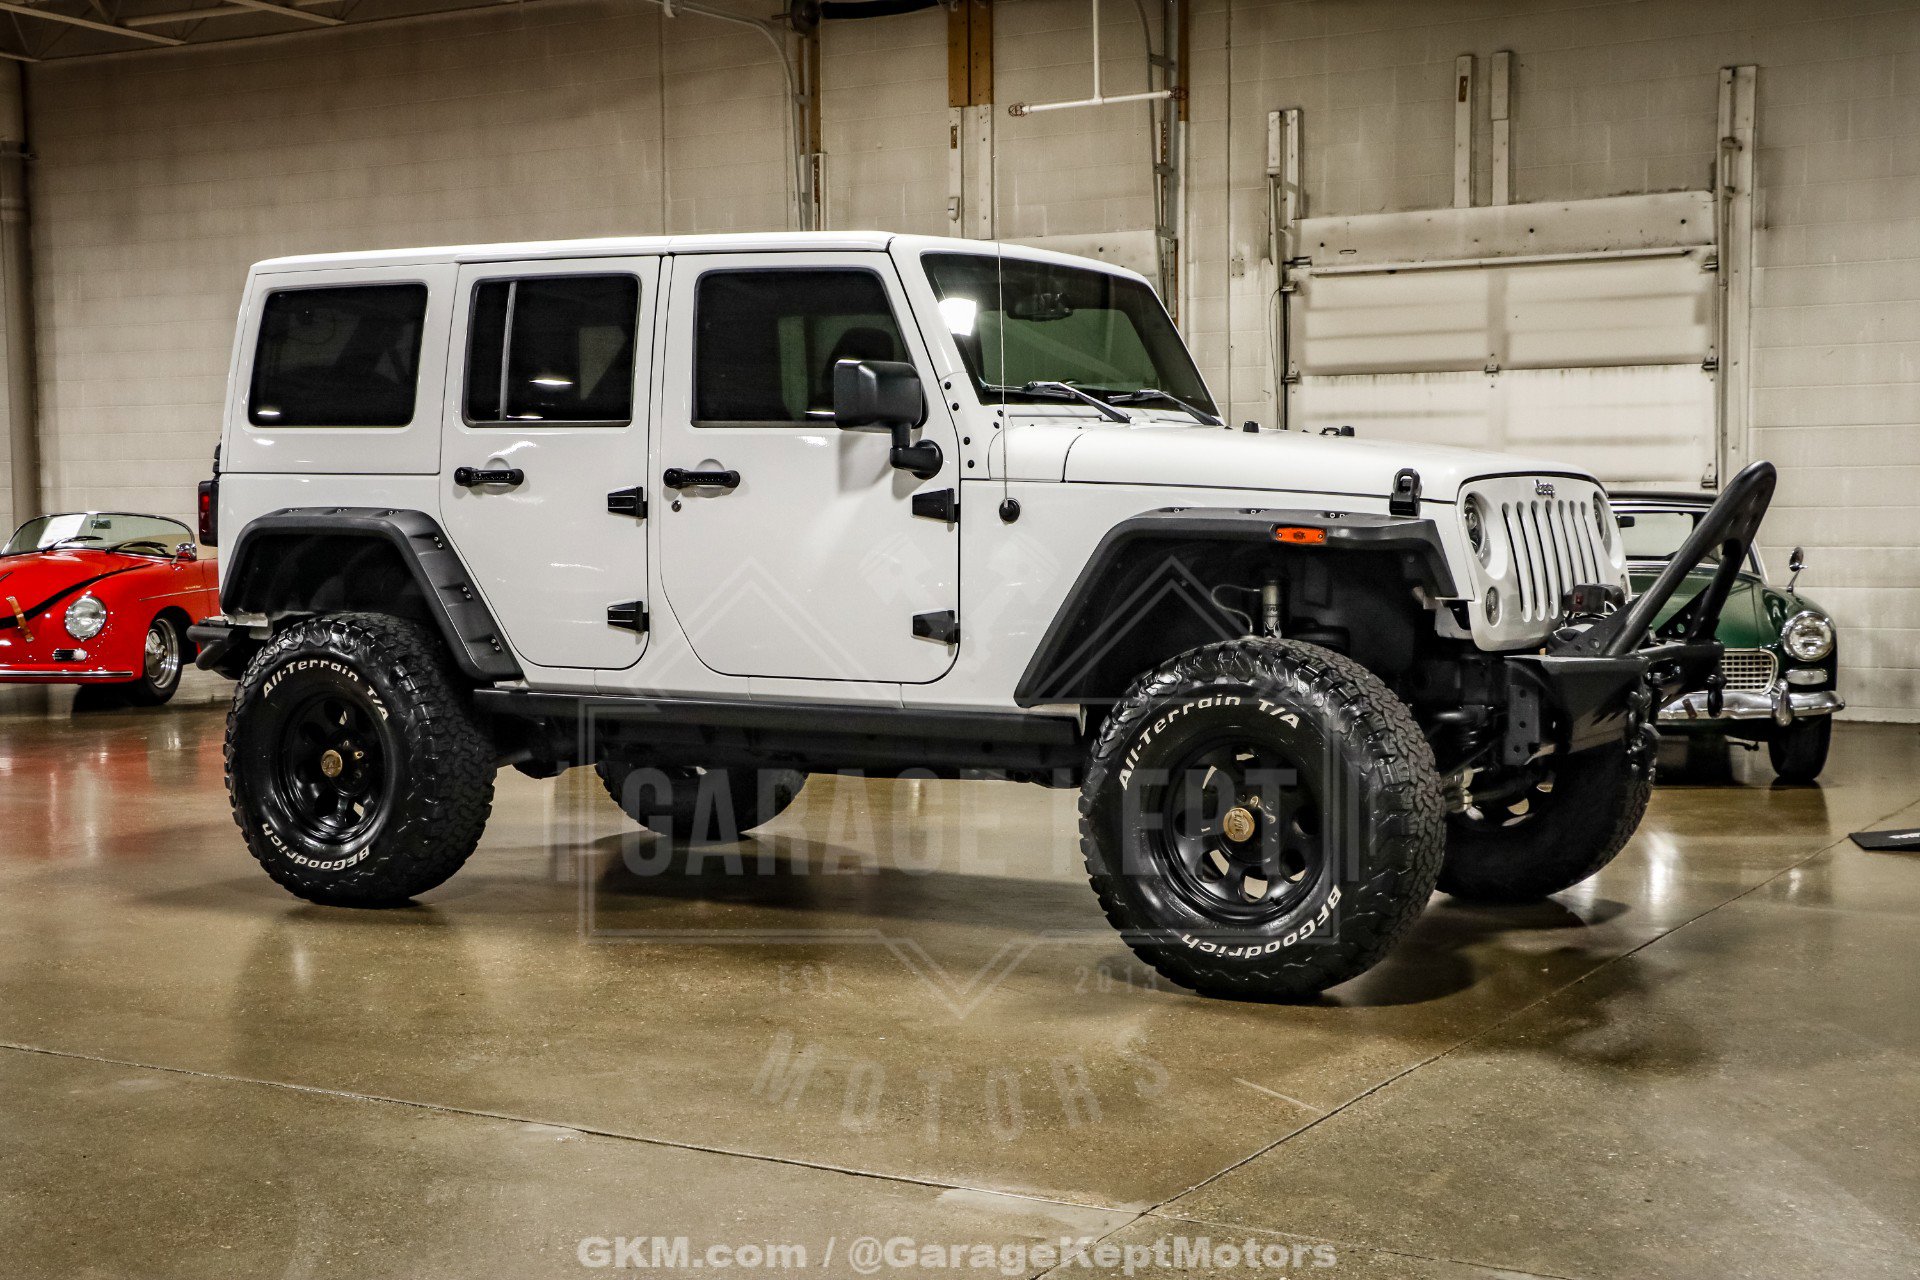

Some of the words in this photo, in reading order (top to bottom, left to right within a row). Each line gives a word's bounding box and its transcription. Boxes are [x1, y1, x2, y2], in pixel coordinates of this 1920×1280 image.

[263, 659, 359, 699] All-Terrain
[367, 685, 389, 721] T/A
[1119, 694, 1241, 791] All-Terrain
[1258, 698, 1300, 729] T/A
[261, 823, 370, 871] BFGoodrich
[1181, 884, 1342, 959] BFGoodrich
